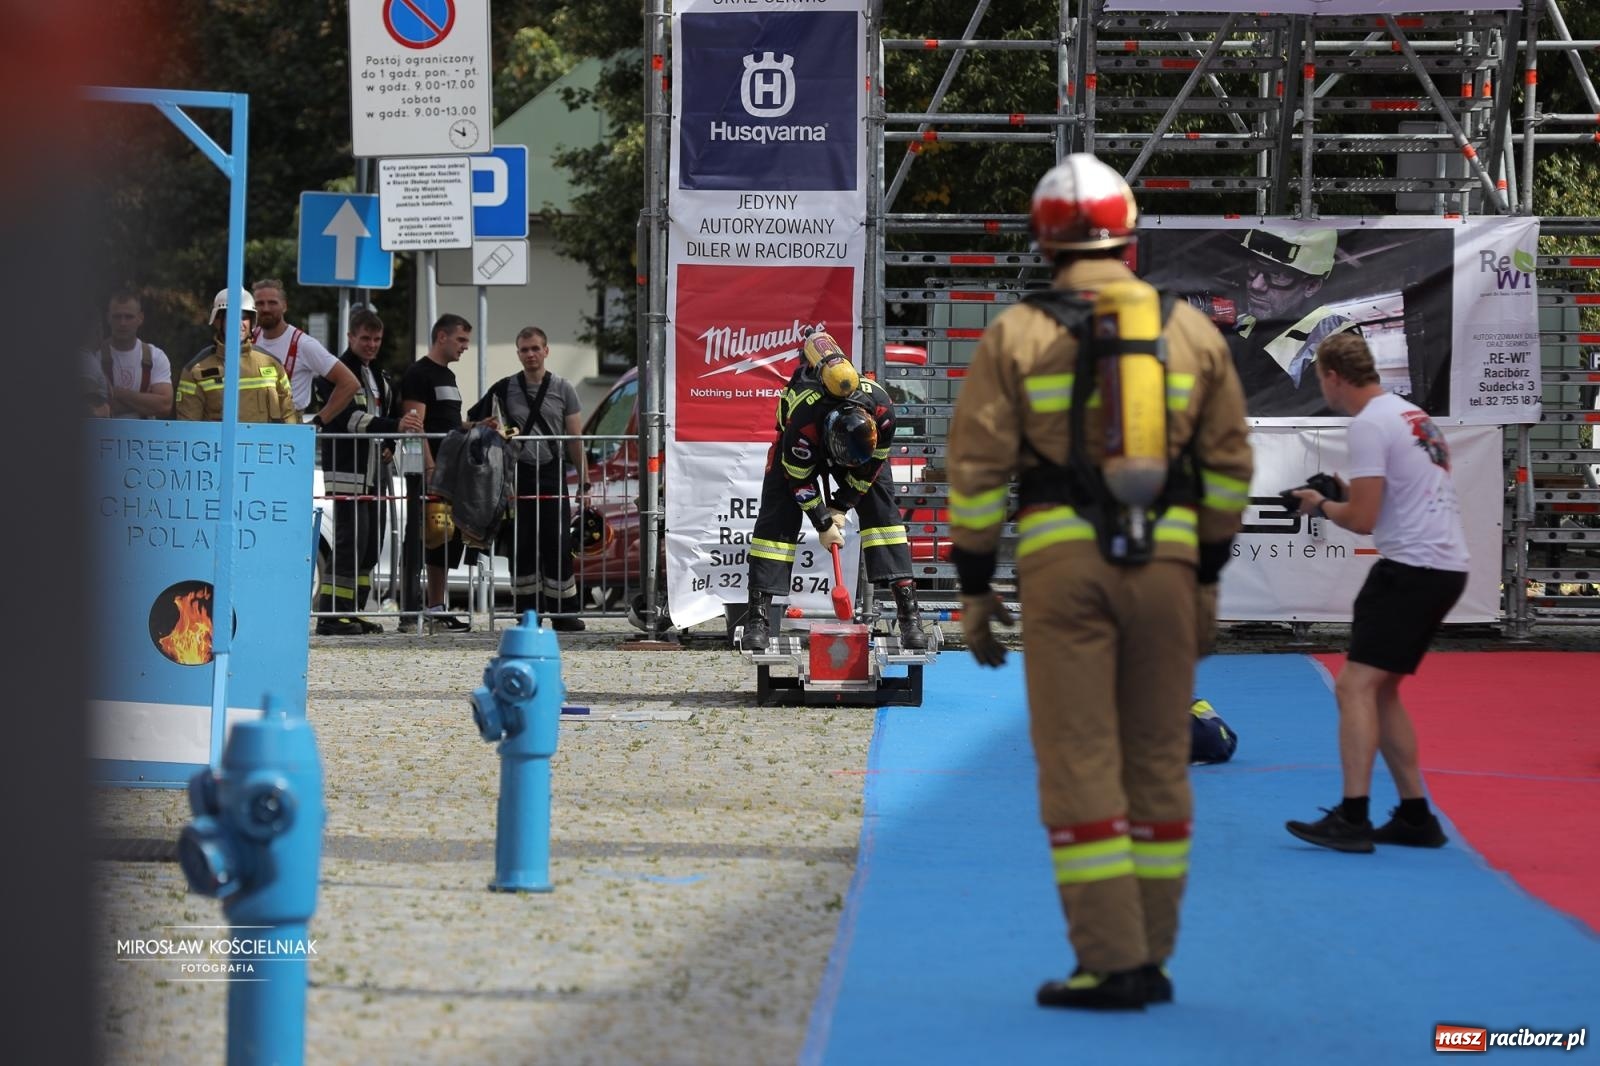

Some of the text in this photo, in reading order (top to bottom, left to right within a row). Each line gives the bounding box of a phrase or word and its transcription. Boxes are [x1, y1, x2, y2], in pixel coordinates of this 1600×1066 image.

[405, 54, 474, 66] ograniczony
[361, 69, 376, 79] do
[380, 70, 384, 78] 1
[389, 68, 420, 80] godz.
[425, 69, 450, 80] pon.
[464, 68, 480, 78] pt.
[379, 82, 410, 94] godz.
[414, 80, 475, 91] 9.00-17.00
[401, 95, 441, 105] sobota
[366, 106, 476, 120] w godz. 9.00-13.00
[710, 122, 826, 144] Husqvarna
[736, 194, 798, 210] JEDYNY
[700, 218, 836, 234] AUTORYZOWANY
[687, 241, 848, 259] DILER W RACIBORZU
[690, 388, 733, 400] Nothing
[735, 388, 752, 397] but
[1479, 380, 1536, 392] Sudecka 3
[1486, 396, 1498, 406] 32
[1501, 396, 1520, 405] 755
[1521, 396, 1530, 405] 18
[123, 468, 256, 493] COMBT
[128, 526, 256, 550] POLAD
[800, 550, 814, 568] 3
[1232, 540, 1346, 562] system
[692, 575, 713, 591] tel.
[718, 573, 742, 588] 32
[809, 576, 830, 596] 74
